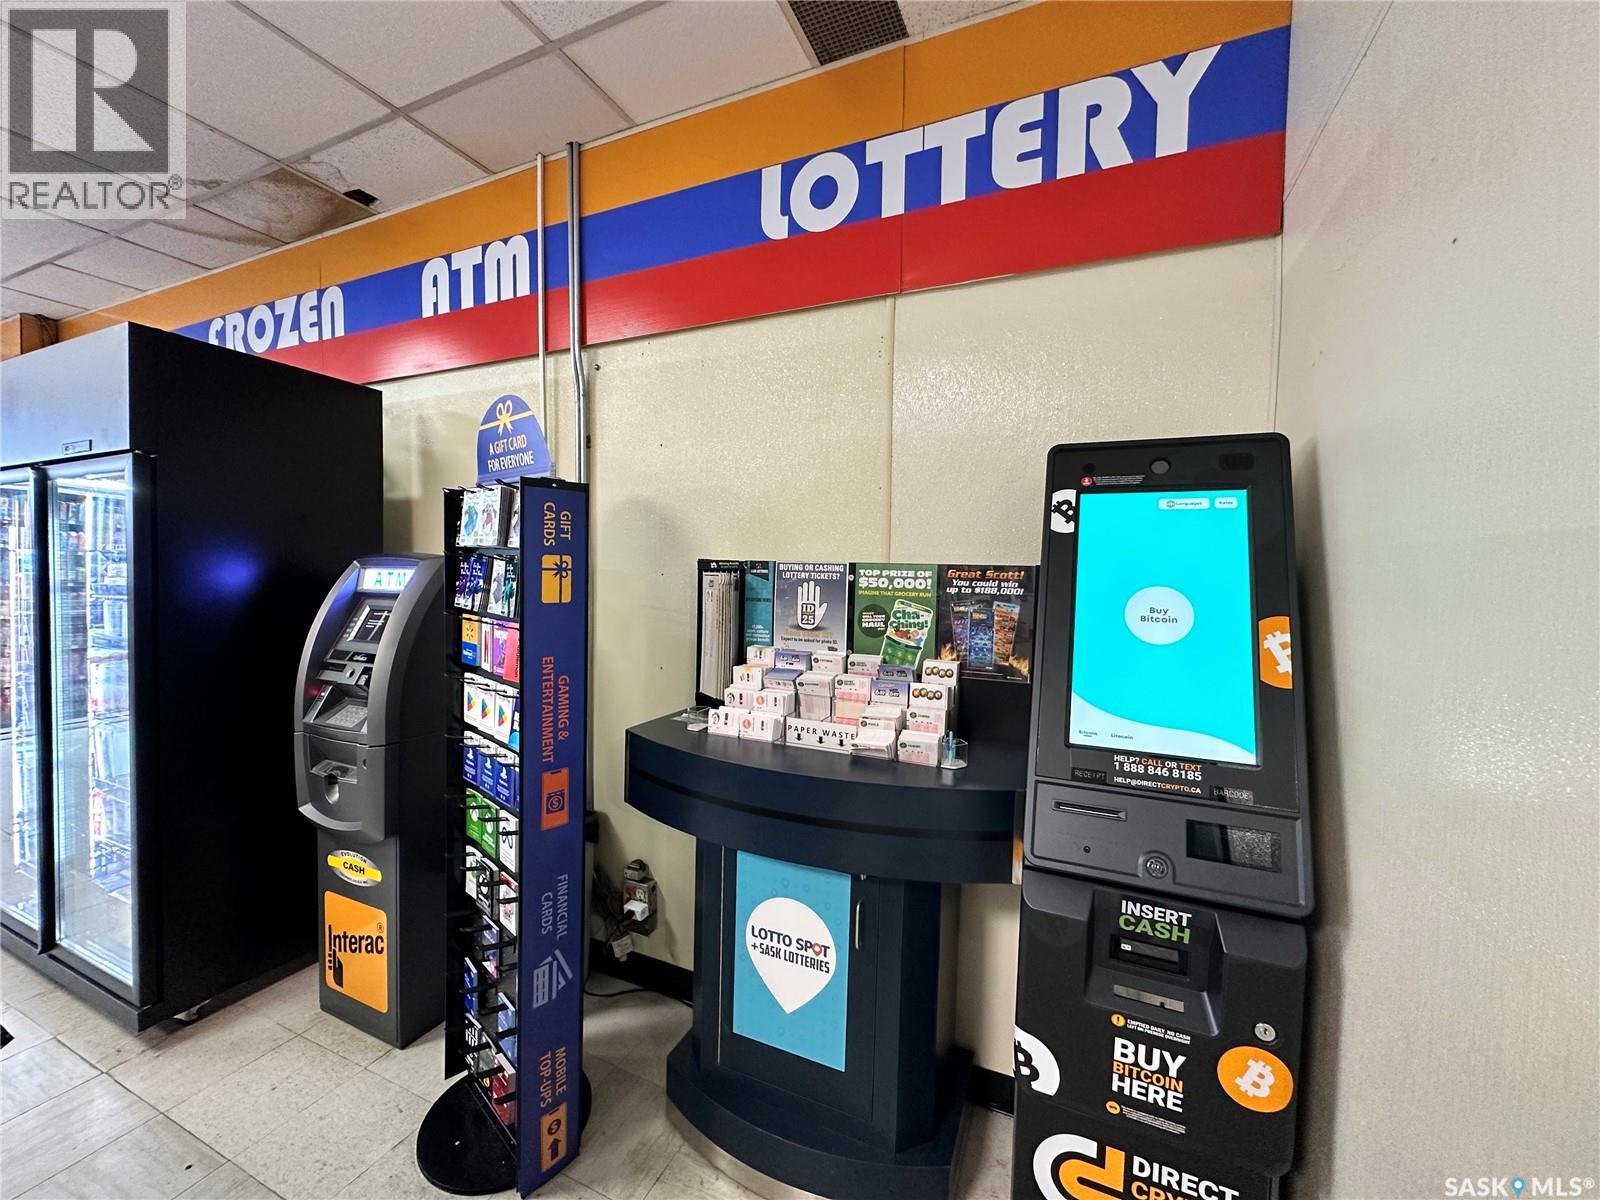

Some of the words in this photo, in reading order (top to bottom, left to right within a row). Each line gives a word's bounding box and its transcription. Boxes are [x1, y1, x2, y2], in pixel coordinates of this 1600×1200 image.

[760, 44, 1222, 240] LOTTERY
[421, 234, 530, 319] ATM
[208, 286, 345, 354] FROZEN
[489, 442, 495, 456] A
[495, 439, 508, 454] GIFT
[508, 434, 527, 451] CARD
[488, 459, 500, 472] FOR
[499, 451, 534, 470] EVERYONE
[543, 502, 556, 546] CARDS
[560, 511, 571, 541] GIFT
[779, 563, 803, 571] BUYING
[815, 564, 844, 572] CASHING
[810, 572, 841, 580] TICKETS?
[947, 569, 982, 578] Great
[985, 570, 1025, 579] Scott!
[859, 576, 932, 590] $50,000!
[946, 586, 958, 594] up
[974, 587, 1024, 595] $188,000!
[1001, 580, 1019, 588] win
[802, 604, 815, 612] ID
[892, 609, 924, 620] Cha-
[1149, 606, 1169, 616] Buy
[802, 615, 815, 624] 25
[889, 620, 928, 630] Ching!
[1140, 616, 1178, 624] Bitcoin
[542, 656, 554, 763] ENTERTAINMENT
[558, 675, 569, 729] GAMING
[558, 730, 569, 741] &
[787, 724, 817, 735] PAPER
[822, 729, 855, 740] WASTE
[1110, 732, 1134, 740] Litecoin
[1114, 754, 1140, 765] HELP?
[1141, 757, 1163, 767] CALL
[1165, 760, 1177, 769] OR
[1179, 762, 1202, 772] TEXT
[1114, 762, 1120, 770] 1
[1123, 763, 1145, 773] 888
[1147, 766, 1170, 777] 846
[1172, 769, 1202, 781] 8185
[1074, 770, 1106, 781] RECEIPT
[1113, 776, 1202, 795] HELP@DIRECTCRYPTO.CA
[340, 851, 367, 864] EVOLUTION
[343, 861, 365, 875] CASH
[541, 892, 553, 935] CARDS
[556, 873, 568, 941] FINANCIAL
[1121, 899, 1192, 927] INSERT
[1118, 914, 1191, 944] CASH
[751, 925, 792, 947] LOTTO
[796, 938, 831, 958] SPOT
[784, 949, 830, 974] LOTTERIES
[1127, 1018, 1150, 1030] EMPTIED
[1175, 1032, 1191, 1041] CASH
[1113, 1036, 1187, 1078] BUY
[539, 1051, 552, 1108] TOP-UPS
[555, 1046, 566, 1096] MOBILE
[1112, 1062, 1184, 1093] BITCOIN
[1111, 1075, 1184, 1113] HERE
[1132, 1155, 1240, 1200] DIRECT
